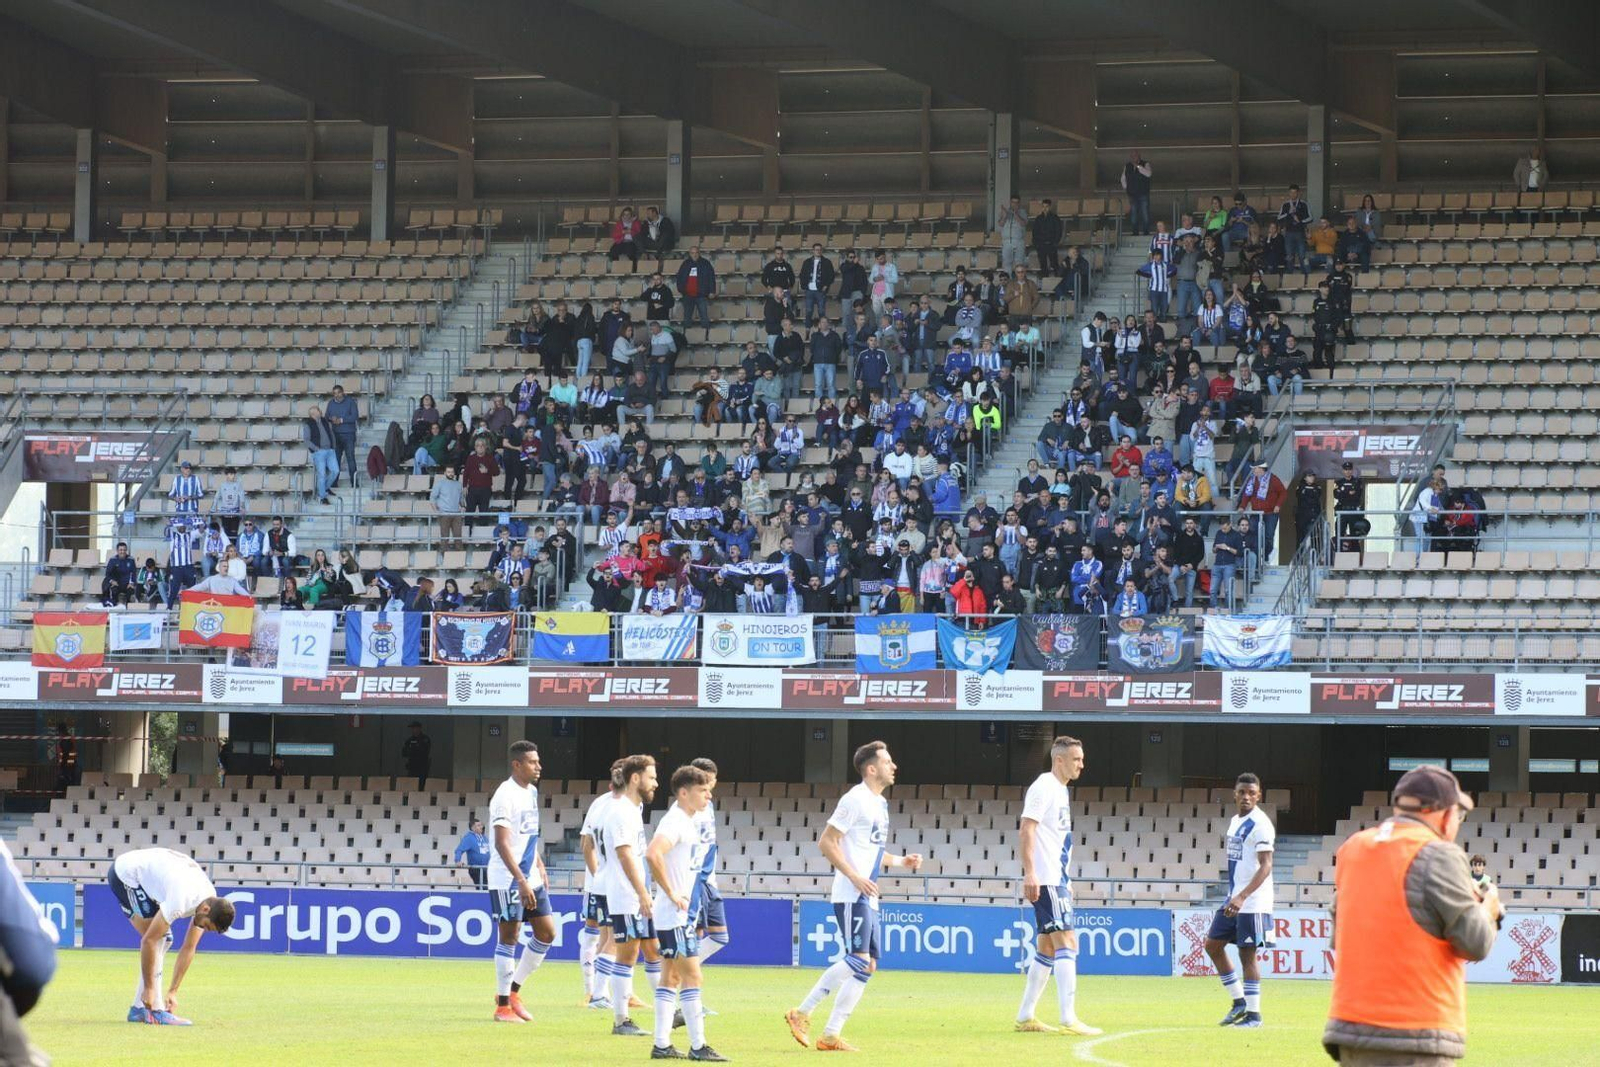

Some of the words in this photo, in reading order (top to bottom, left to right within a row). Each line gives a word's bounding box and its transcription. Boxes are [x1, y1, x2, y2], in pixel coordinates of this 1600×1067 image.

[30, 440, 87, 455] PLAY
[1295, 436, 1353, 451] PLAY
[743, 623, 808, 635] HINOJEROS
[292, 634, 317, 657] 12
[752, 642, 770, 653] ON
[773, 642, 802, 653] TOUR
[47, 672, 107, 688] PLAY
[230, 678, 276, 687] Ayuntamiento
[292, 675, 351, 692] PLAY
[475, 680, 522, 689] Ayuntamiento
[539, 678, 600, 694] PLAY
[726, 682, 774, 690] Ayuntamiento
[238, 685, 256, 693] Jerez
[475, 687, 484, 695] de
[484, 687, 501, 696] Jerez
[735, 689, 753, 697] Jerez
[792, 680, 855, 696] PLAY
[985, 684, 1035, 693] Ayuntamiento
[1053, 681, 1119, 698] PLAY
[1252, 686, 1303, 695] Ayuntamiento
[1322, 684, 1387, 700] PLAY
[1526, 688, 1577, 697] Ayuntamiento
[994, 691, 1013, 699] Jerez
[1261, 694, 1280, 702] Jerez
[1536, 696, 1555, 704] Jerez
[506, 889, 520, 904] 12
[1058, 897, 1071, 913] 16
[225, 891, 402, 954] Grupo
[416, 896, 586, 947] Soer
[853, 917, 864, 934] 7
[1074, 912, 1113, 926] ínicas
